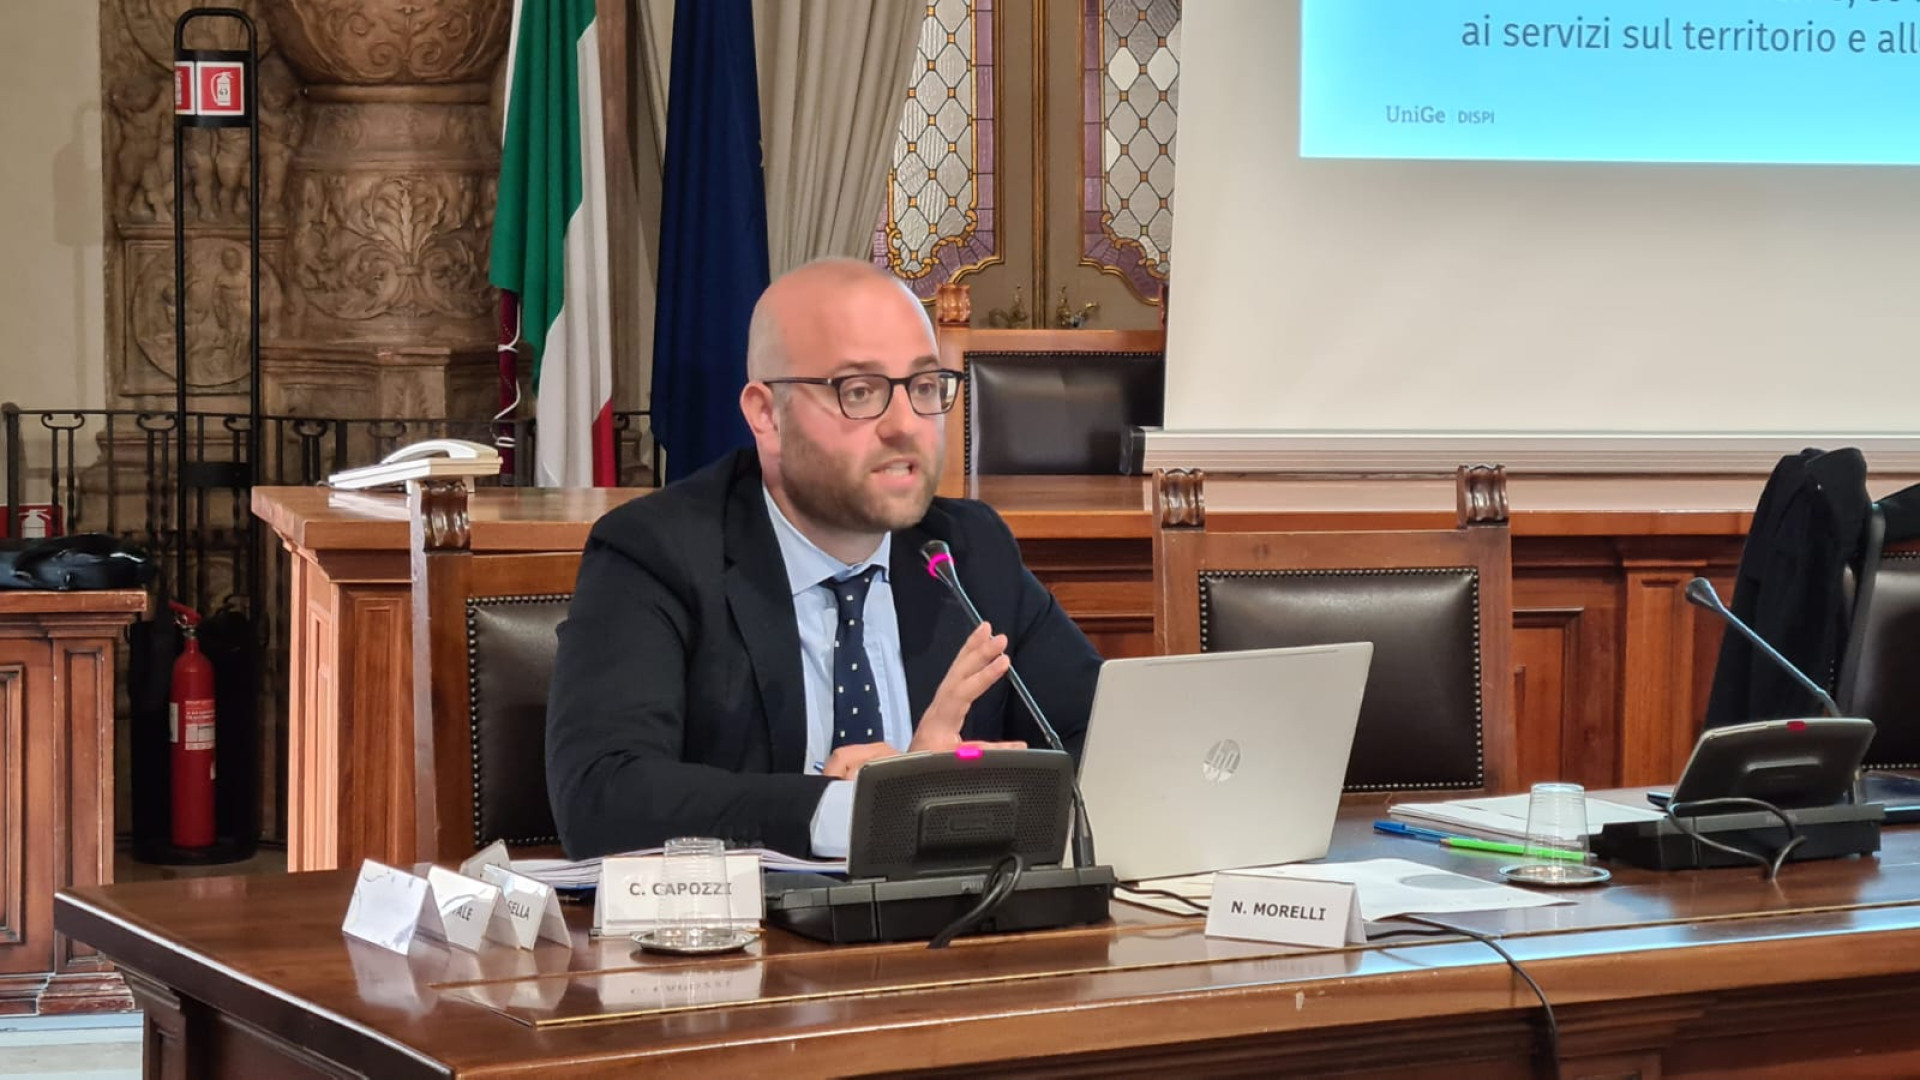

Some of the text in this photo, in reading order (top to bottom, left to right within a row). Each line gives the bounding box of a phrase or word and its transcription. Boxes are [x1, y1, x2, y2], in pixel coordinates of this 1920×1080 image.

[1461, 14, 1920, 54] ai servizi sul territorio e all
[1386, 105, 1495, 124] UniGe DISPI
[629, 882, 733, 896] C. CAPOZZI
[1231, 900, 1326, 921] N. MORELLI
